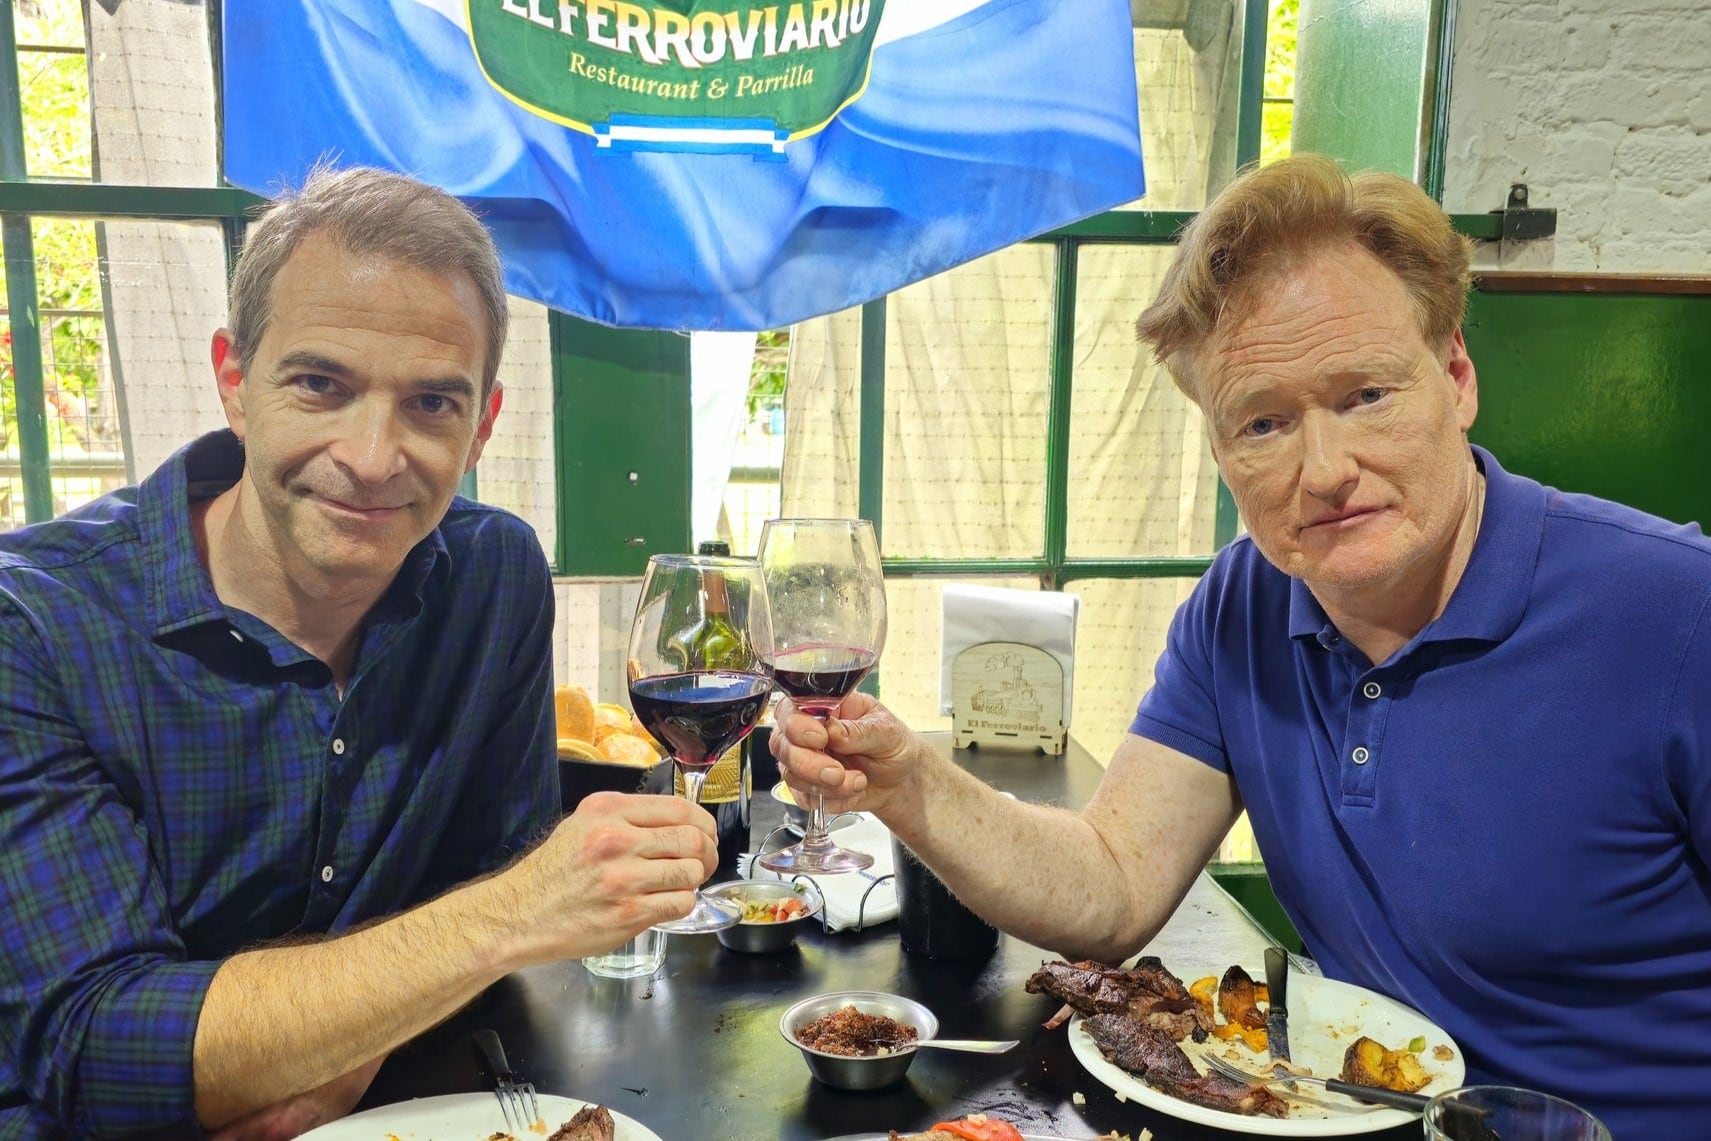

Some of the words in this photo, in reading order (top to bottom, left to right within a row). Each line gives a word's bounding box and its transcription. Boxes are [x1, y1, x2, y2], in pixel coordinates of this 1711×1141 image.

[556, 0, 871, 69] FERROVIARIO
[569, 51, 701, 99] Restaurant
[706, 78, 729, 99] &
[735, 63, 814, 98] Parrilla
[967, 719, 979, 728] El
[981, 720, 1047, 732] Ferroviario
